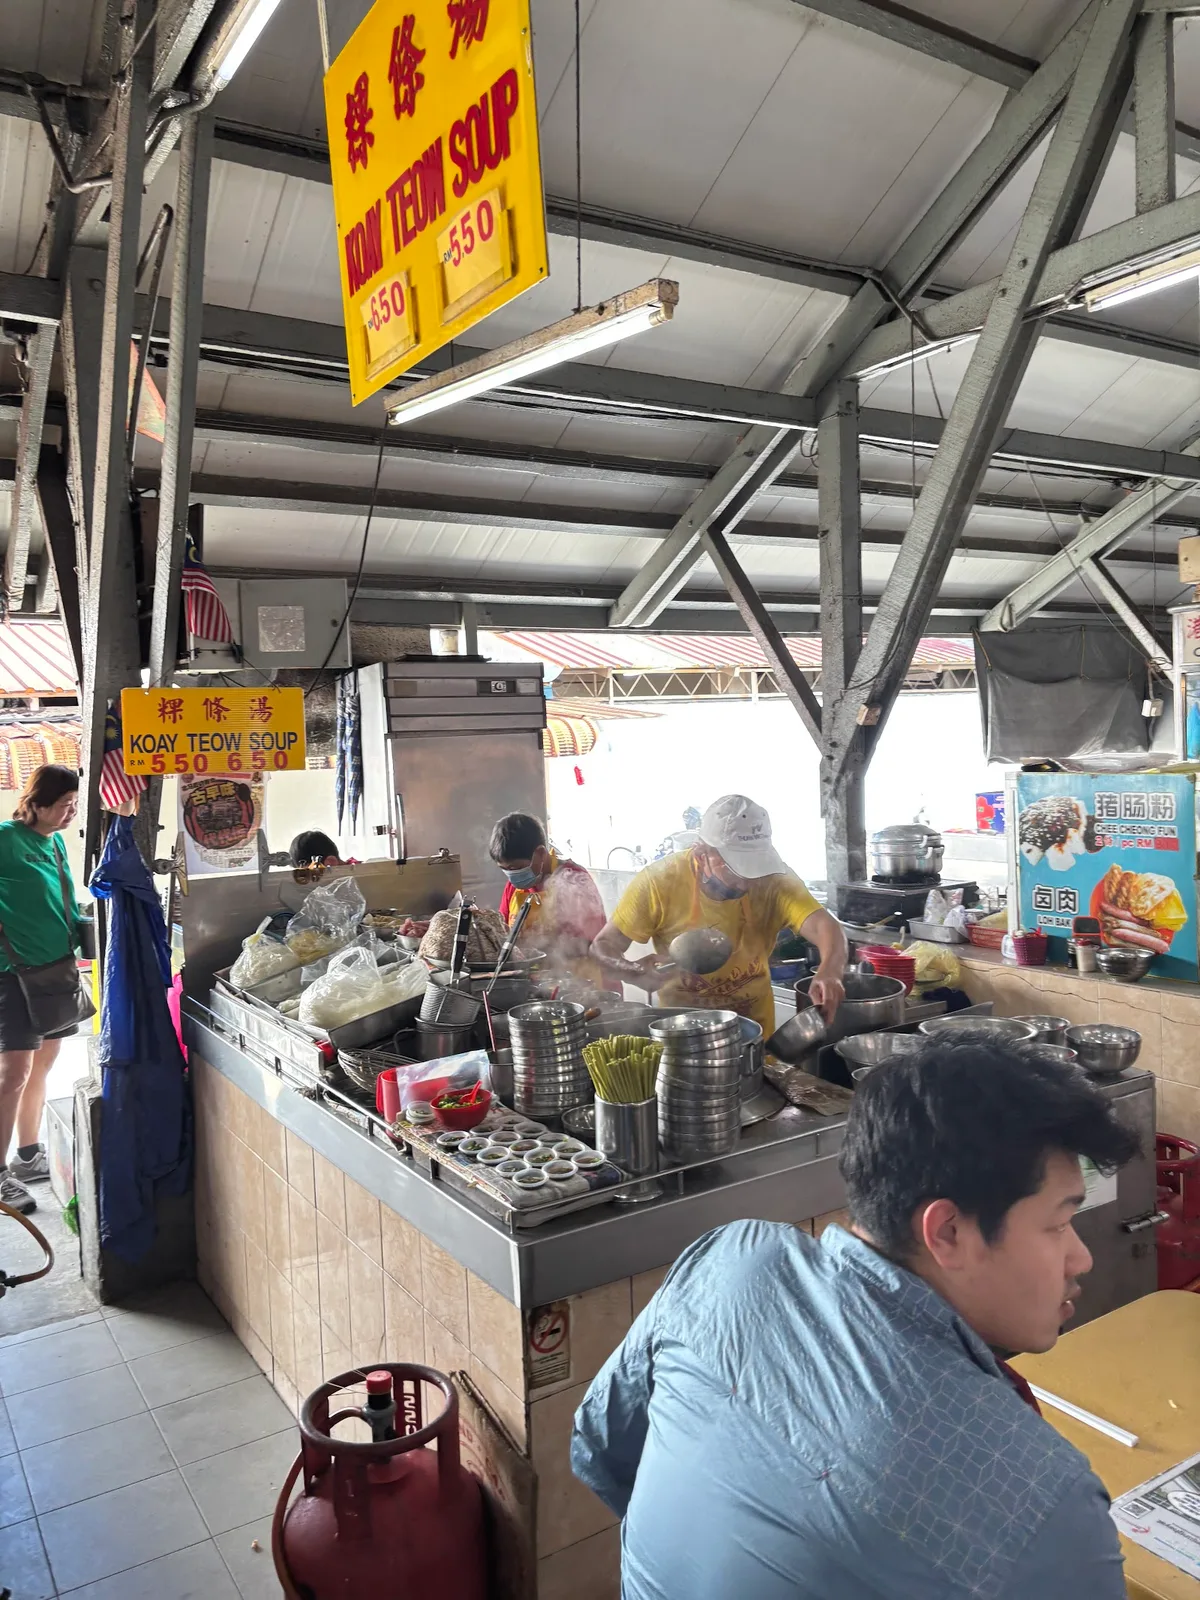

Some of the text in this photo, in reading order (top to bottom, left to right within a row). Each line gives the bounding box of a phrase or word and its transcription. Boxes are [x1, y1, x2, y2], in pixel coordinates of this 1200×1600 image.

[344, 68, 519, 297] KOAY TEOW SOUP
[129, 731, 298, 754] KOAY TEOW SOUP
[1096, 793, 1175, 820] 猪肠粉
[1095, 823, 1177, 837] CHEE CHEONG FUN
[1034, 886, 1077, 912] 卤肉
[1037, 915, 1054, 925] LOH
